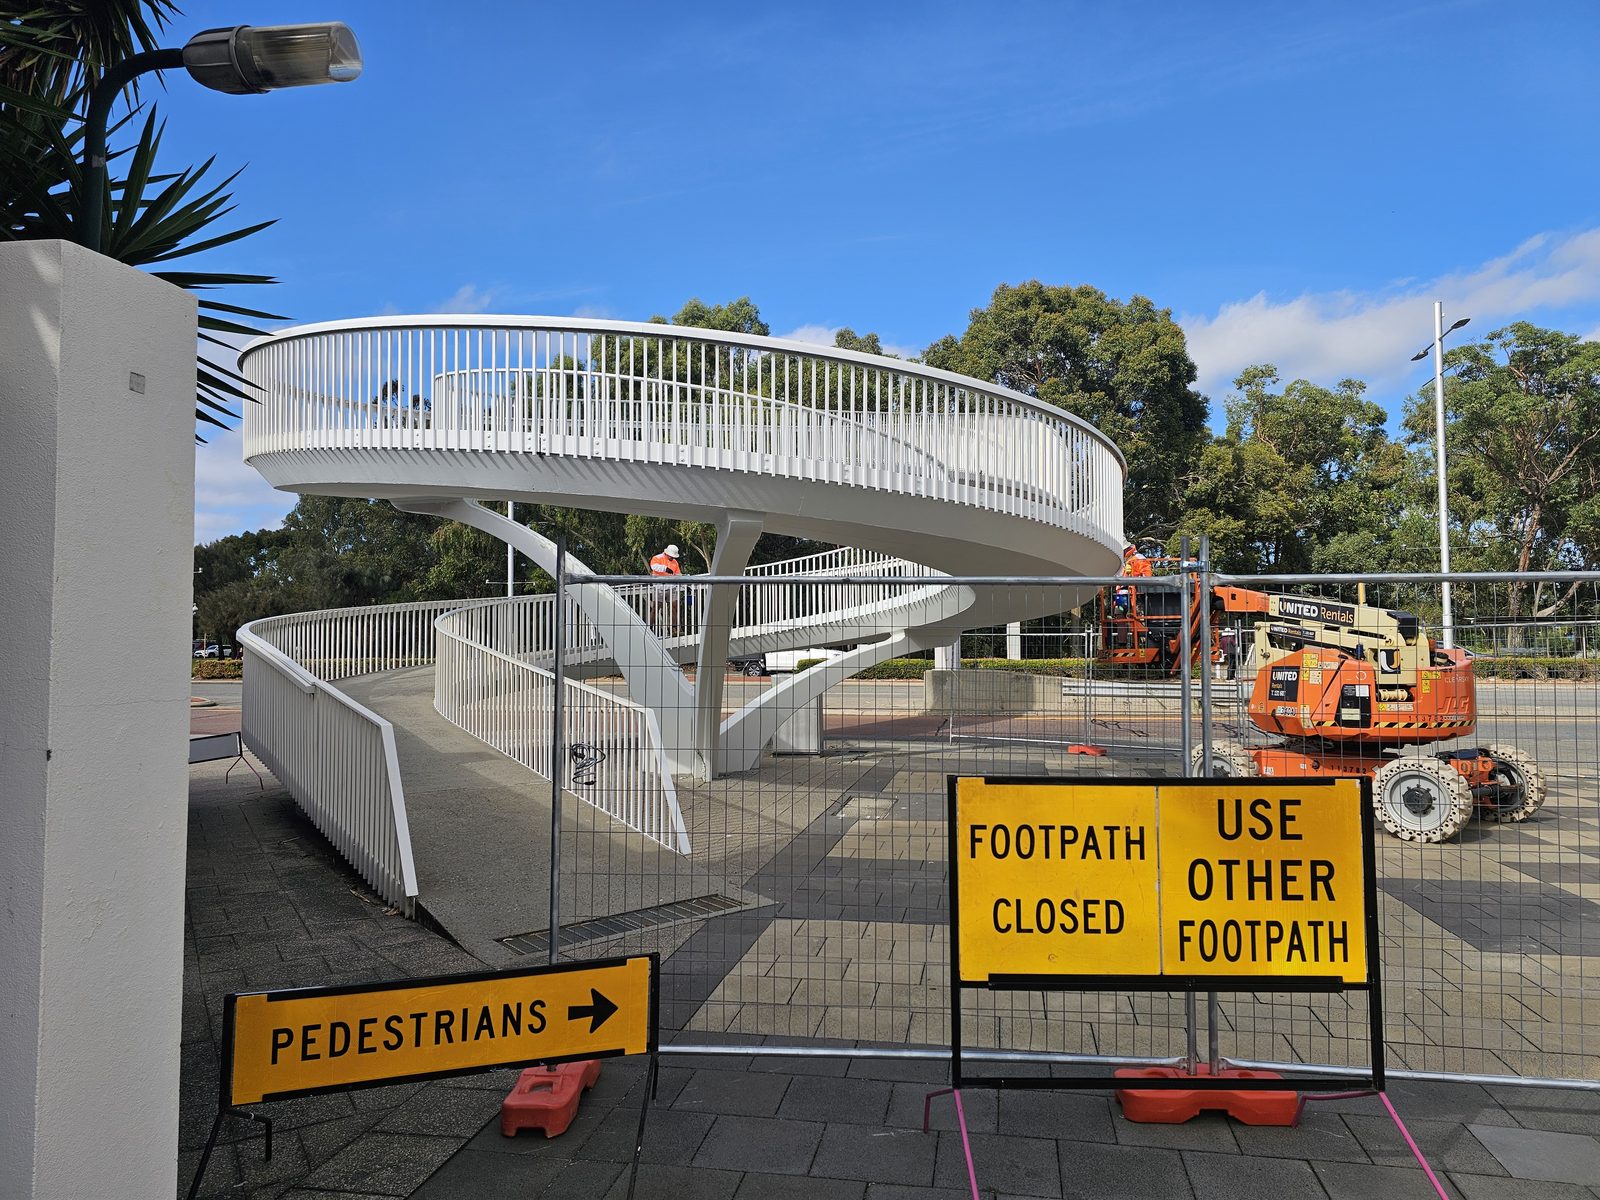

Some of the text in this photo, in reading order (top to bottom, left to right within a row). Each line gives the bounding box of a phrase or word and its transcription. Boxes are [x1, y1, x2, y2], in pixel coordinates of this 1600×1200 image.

[1279, 601, 1354, 623] UNITED Rentals
[1272, 671, 1298, 681] UNITED
[1437, 696, 1470, 714] JLG
[1217, 798, 1303, 841] USE
[970, 823, 1146, 861] FOOTPATH
[1187, 858, 1336, 902] OTHER
[992, 897, 1125, 935] CLOSED
[1178, 919, 1349, 963] FOOTPATH
[270, 999, 548, 1065] PEDESTRIANS
